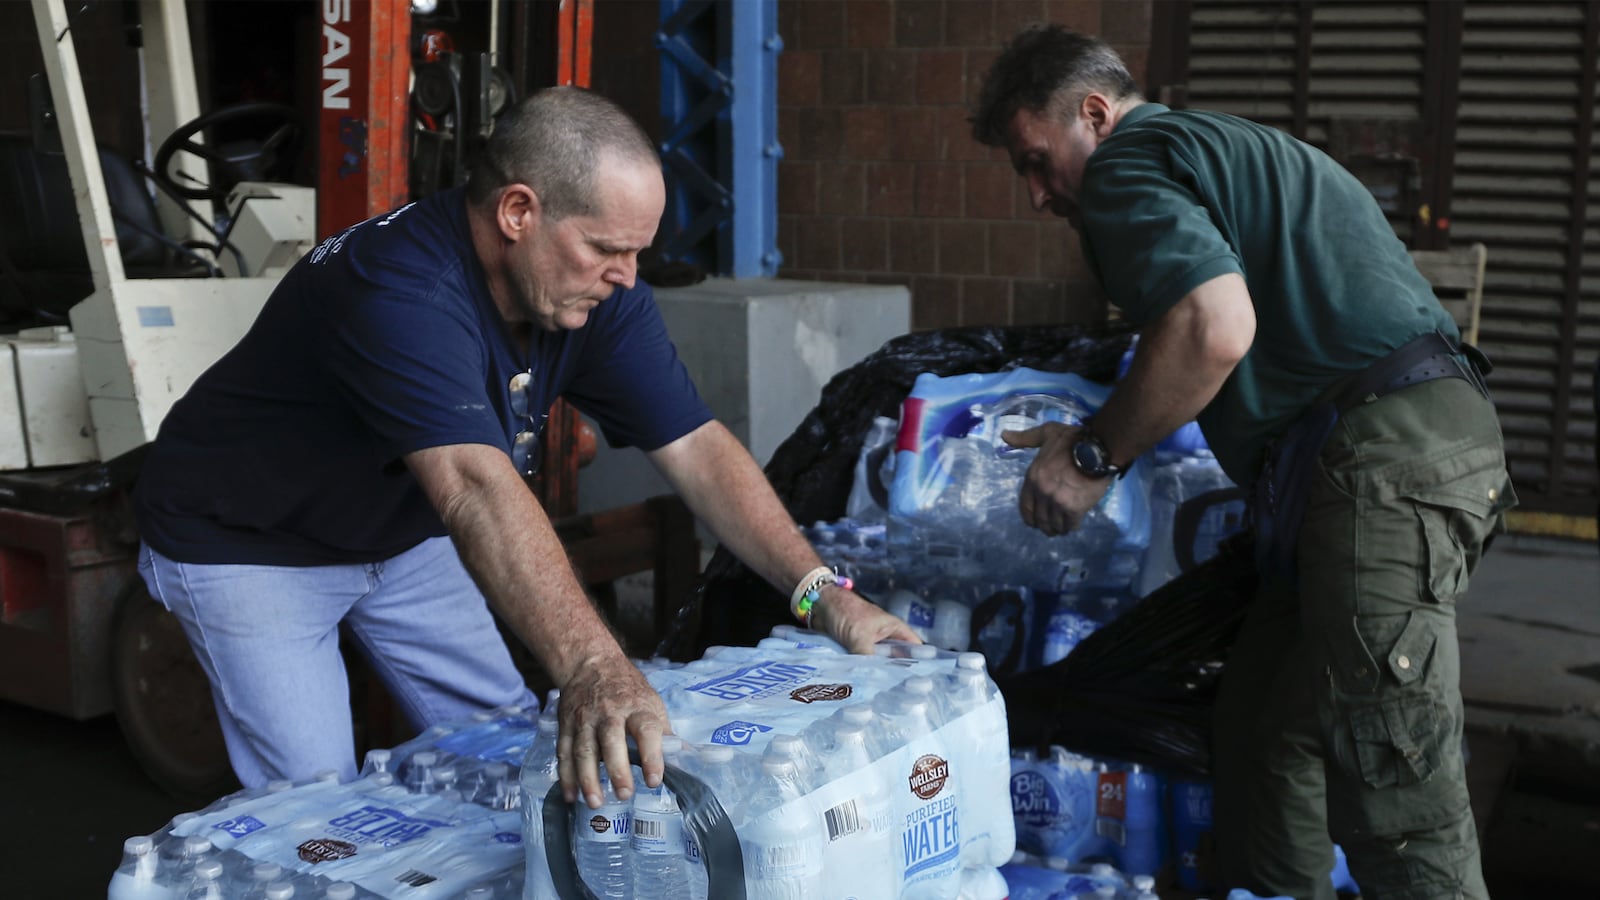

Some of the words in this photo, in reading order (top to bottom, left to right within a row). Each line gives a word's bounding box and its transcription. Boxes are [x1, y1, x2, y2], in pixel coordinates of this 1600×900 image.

[700, 663, 817, 700] WATER
[910, 763, 948, 789] WELLSLEY
[1013, 774, 1045, 796] Big
[1013, 793, 1050, 812] Win
[1101, 783, 1123, 801] 24
[906, 794, 956, 828] PURIFIED
[903, 807, 960, 867] WATER
